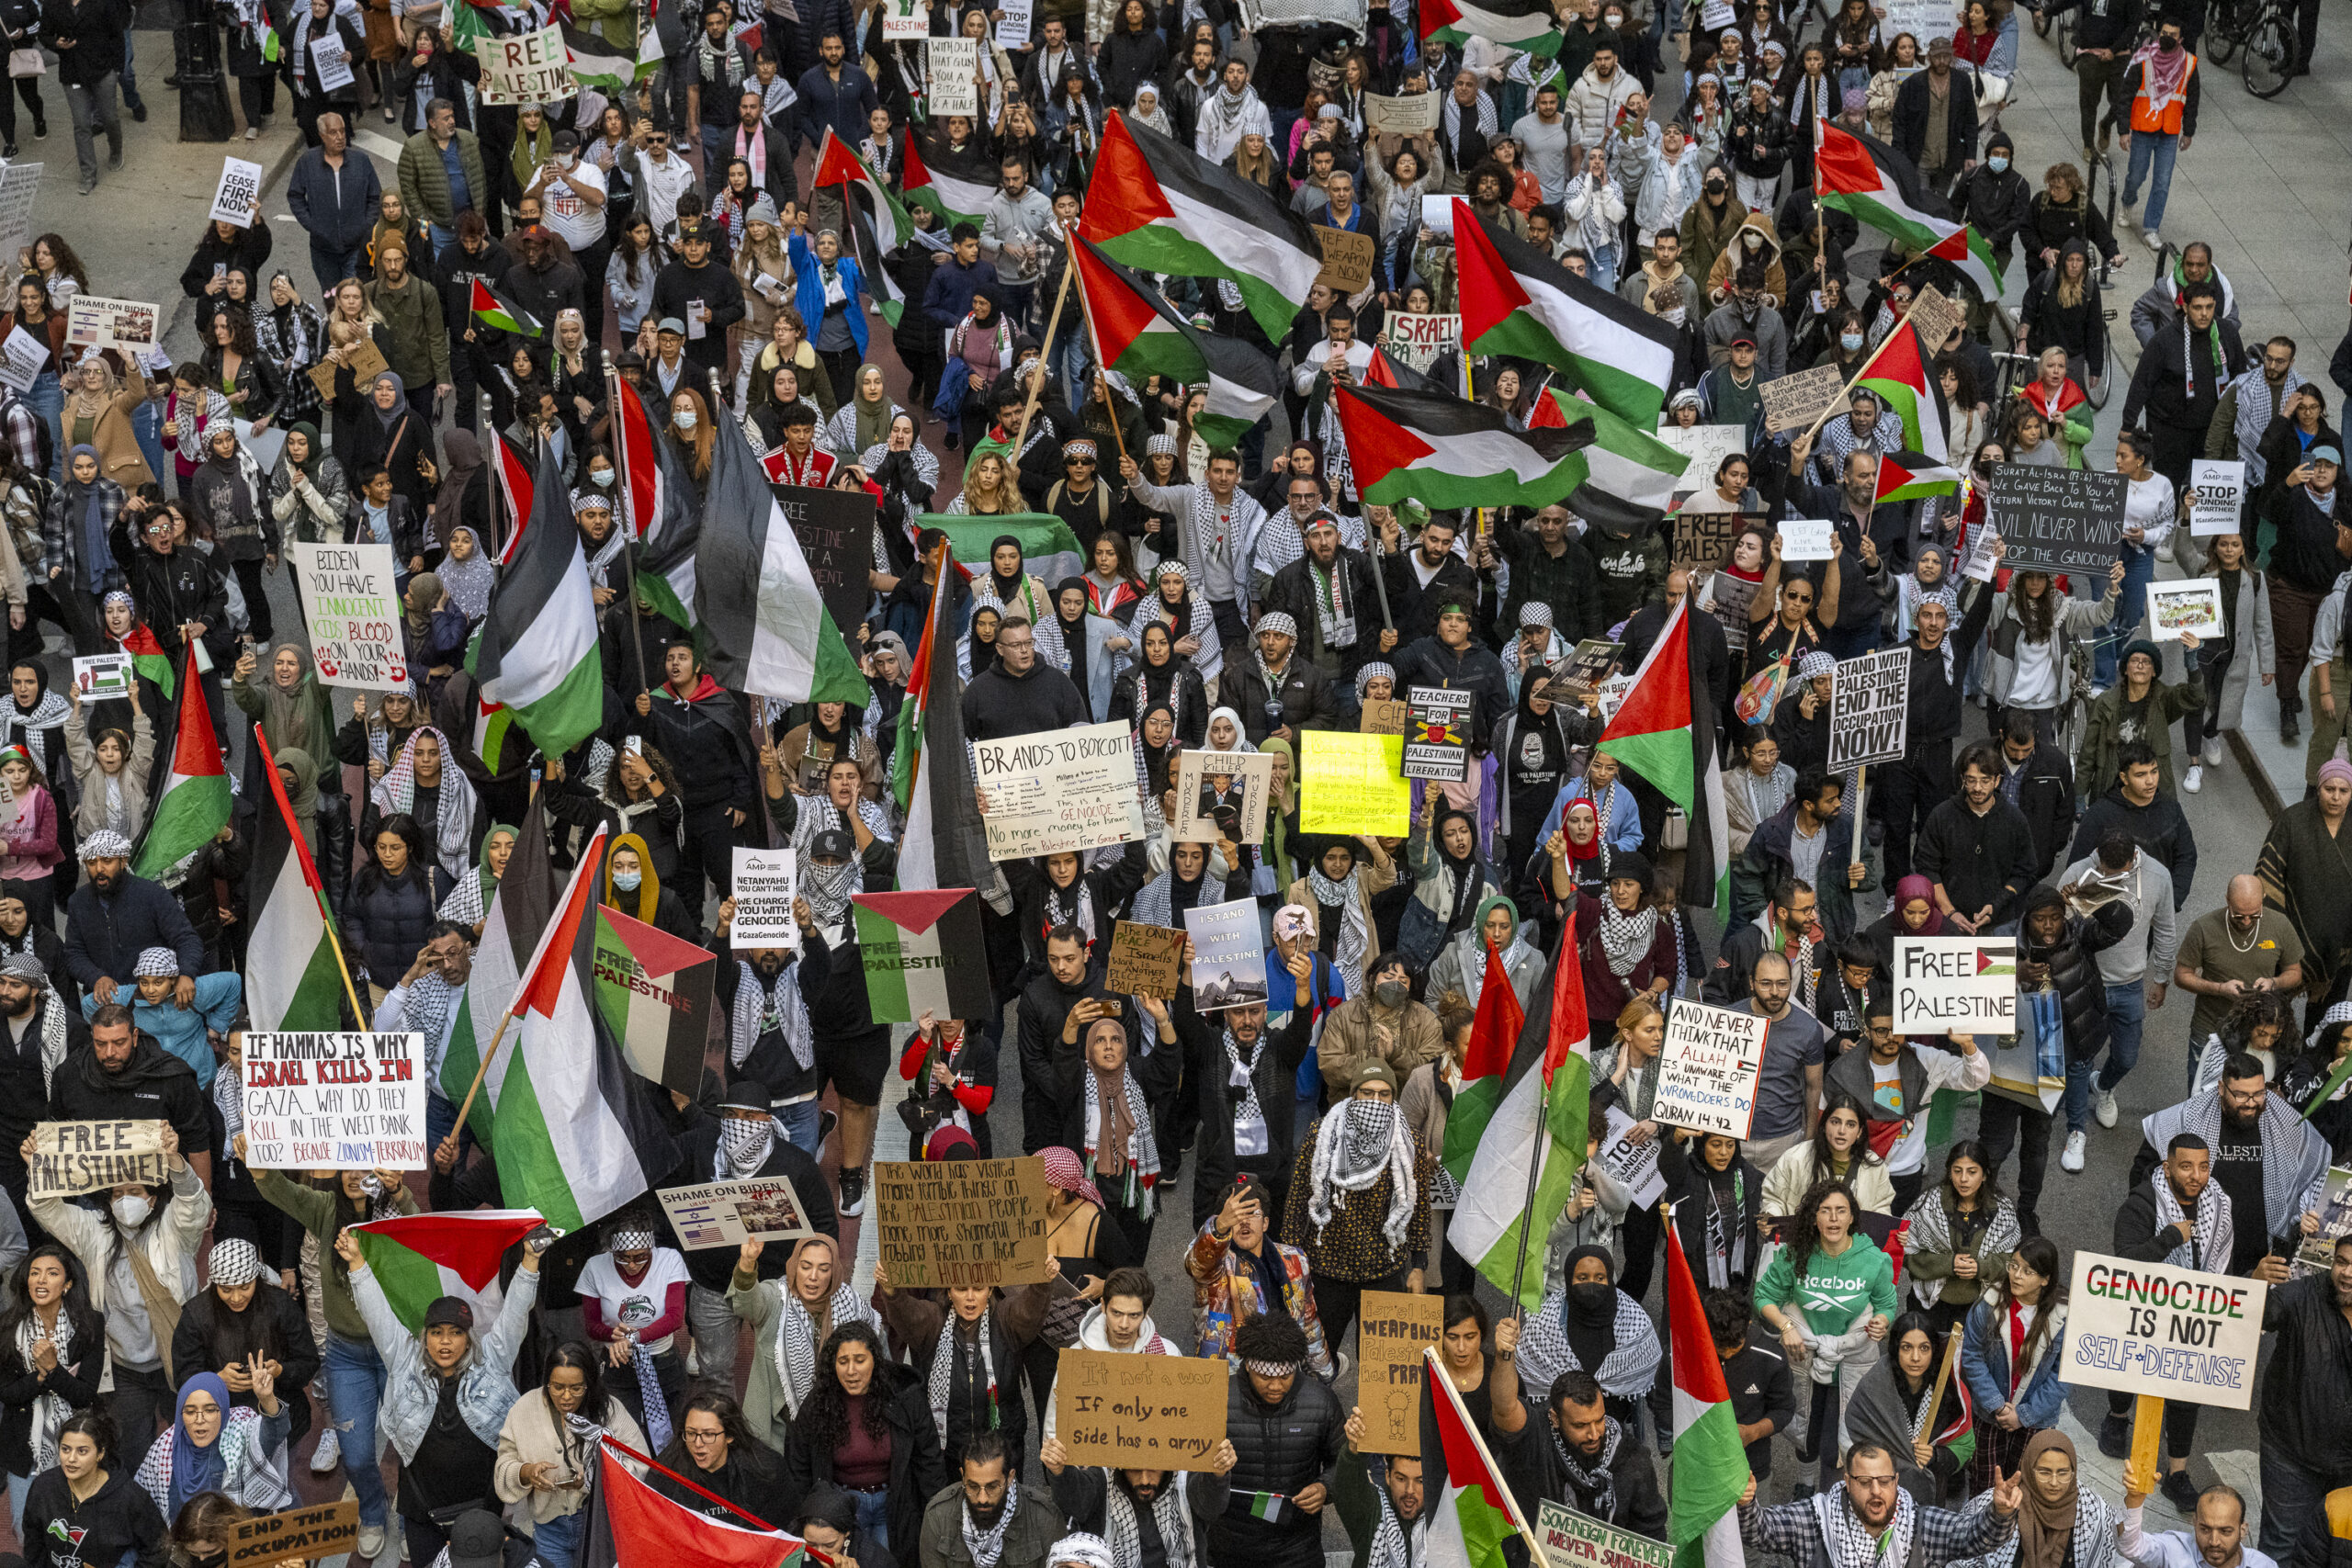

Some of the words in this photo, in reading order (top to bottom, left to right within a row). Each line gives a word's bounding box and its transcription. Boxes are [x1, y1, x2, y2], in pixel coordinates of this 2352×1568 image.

[883, 20, 929, 31] PALESTINE
[1002, 12, 1028, 22] STOP
[317, 47, 342, 60] ISRAEL
[486, 31, 559, 68] FREE
[931, 40, 976, 54] WITHOUT
[930, 57, 951, 67] THAT
[954, 57, 975, 69] GUN
[935, 69, 954, 83] YOU
[956, 72, 965, 83] A
[935, 84, 967, 95] BITCH
[226, 174, 255, 189] CEASE
[221, 185, 254, 202] FIRE
[218, 197, 252, 213] NOW
[556, 199, 580, 215] NFL
[1351, 238, 1364, 253] IS
[1327, 249, 1371, 267] WEAPON
[1338, 265, 1364, 280] NOW
[73, 298, 107, 310] SHAME
[108, 303, 122, 311] ON
[124, 305, 153, 315] BIDEN
[1759, 384, 1768, 393] IF
[1792, 372, 1808, 383] ARE
[2195, 498, 2236, 506] FUNDING
[2196, 485, 2237, 499] STOP
[1678, 512, 1732, 538] FREE
[2030, 512, 2075, 542] NEVER
[2084, 517, 2121, 545] WINS
[316, 550, 359, 570] BIDEN
[2032, 547, 2053, 562] THE
[309, 572, 334, 592] YOU
[338, 575, 378, 594] HAVE
[314, 596, 387, 617] INNOCENT
[312, 618, 343, 639] KIDS
[348, 621, 393, 643] BLOOD
[330, 641, 348, 660] ON
[354, 642, 386, 661] YOUR
[1589, 645, 1611, 656] STOP
[339, 662, 379, 682] HANDS!
[1577, 656, 1594, 665] U.S.
[1594, 659, 1609, 668] AID
[1838, 658, 1876, 679] STAND
[1878, 650, 1908, 671] WITH
[1577, 669, 1591, 678] TO
[1836, 666, 1906, 695] PALESTINE!
[1412, 691, 1469, 704] TEACHERS
[1835, 690, 1871, 717] END
[1875, 682, 1905, 708] THE
[1429, 709, 1448, 720] FOR
[1833, 706, 1904, 733] OCCUPATION
[1831, 720, 1902, 762] NOW!
[979, 744, 1054, 775] BRANDS
[1056, 741, 1076, 762] TO
[1079, 735, 1132, 759] BOYCOTT
[1204, 754, 1246, 765] CHILD
[1407, 747, 1463, 761] PALESTINIAN
[1204, 764, 1242, 773] KILLER
[1047, 821, 1083, 837] money
[1087, 818, 1101, 828] for
[1103, 815, 1131, 825] Israel's
[1080, 834, 1094, 845] Free
[1097, 833, 1117, 844] Gaza
[737, 876, 789, 885] NETANYAHU
[738, 906, 760, 914] YOU
[763, 906, 790, 914] WITH
[1206, 908, 1245, 922] STAND
[738, 917, 790, 926] GENOCIDE
[1116, 932, 1152, 947] PEACE
[1209, 931, 1240, 942] WITH
[596, 946, 645, 978] FREE
[1195, 950, 1259, 965] PALESTINE
[1905, 946, 1973, 978] FREE
[594, 963, 692, 1015] PALESTINE
[1110, 979, 1176, 998] PALESTINE
[1900, 987, 2016, 1023] PALESTINE
[1673, 1004, 1702, 1025] AND
[1705, 1011, 1754, 1036] NEVER
[247, 1034, 267, 1059] IF
[342, 1034, 366, 1059] IS
[373, 1034, 409, 1059] WHY
[1670, 1022, 1710, 1045] THINK
[1713, 1032, 1754, 1056] THAT
[1680, 1045, 1727, 1067] ALLAH
[247, 1060, 308, 1088] ISRAEL
[316, 1059, 372, 1084] KILLS
[379, 1058, 413, 1082] IN
[1662, 1058, 1678, 1068] IS
[1684, 1063, 1725, 1079] UNAWARE
[1729, 1071, 1748, 1083] OF
[1666, 1071, 1700, 1088] WHAT
[1710, 1079, 1734, 1093] THE
[247, 1089, 312, 1116] GAZA...
[315, 1089, 344, 1113] WHY
[353, 1088, 370, 1111] DO
[377, 1087, 405, 1111] THEY
[1654, 1100, 1694, 1123] QURAN
[1735, 1097, 1751, 1111] DO
[250, 1118, 281, 1141] KILL
[290, 1119, 304, 1138] IN
[311, 1116, 335, 1138] THE
[342, 1115, 375, 1136] WEST
[379, 1113, 413, 1135] BANK
[58, 1122, 133, 1153] FREE
[254, 1143, 284, 1164] TOO?
[293, 1142, 332, 1164] BECAUSE
[31, 1153, 166, 1192] PALESTINE!
[663, 1189, 712, 1203] SHAME
[715, 1186, 736, 1196] ON
[739, 1182, 782, 1195] BIDEN
[1797, 1274, 1867, 1292] Reebok
[2086, 1264, 2248, 1319] GENOCIDE
[1421, 1303, 1442, 1321] has
[1363, 1319, 1442, 1341] WEAPONS
[2126, 1306, 2157, 1338] IS
[2168, 1314, 2222, 1348] NOT
[1081, 1360, 1109, 1387] It
[1121, 1361, 1153, 1386] not
[1161, 1374, 1172, 1385] a
[1178, 1371, 1215, 1386] war
[1361, 1364, 1386, 1383] has
[1075, 1396, 1103, 1412] If
[1113, 1396, 1153, 1423] only
[1161, 1406, 1188, 1417] one
[1073, 1427, 1109, 1445] side
[1117, 1426, 1141, 1449] has
[1148, 1438, 1159, 1449] a
[1169, 1437, 1213, 1459] army
[238, 1518, 283, 1540] END
[293, 1508, 337, 1527] THE
[233, 1523, 358, 1561] OCCUPATION
[1541, 1506, 1607, 1547] SOVEREIGN
[1611, 1532, 1669, 1568] FOREVER
[1547, 1529, 1597, 1562] NEVER
